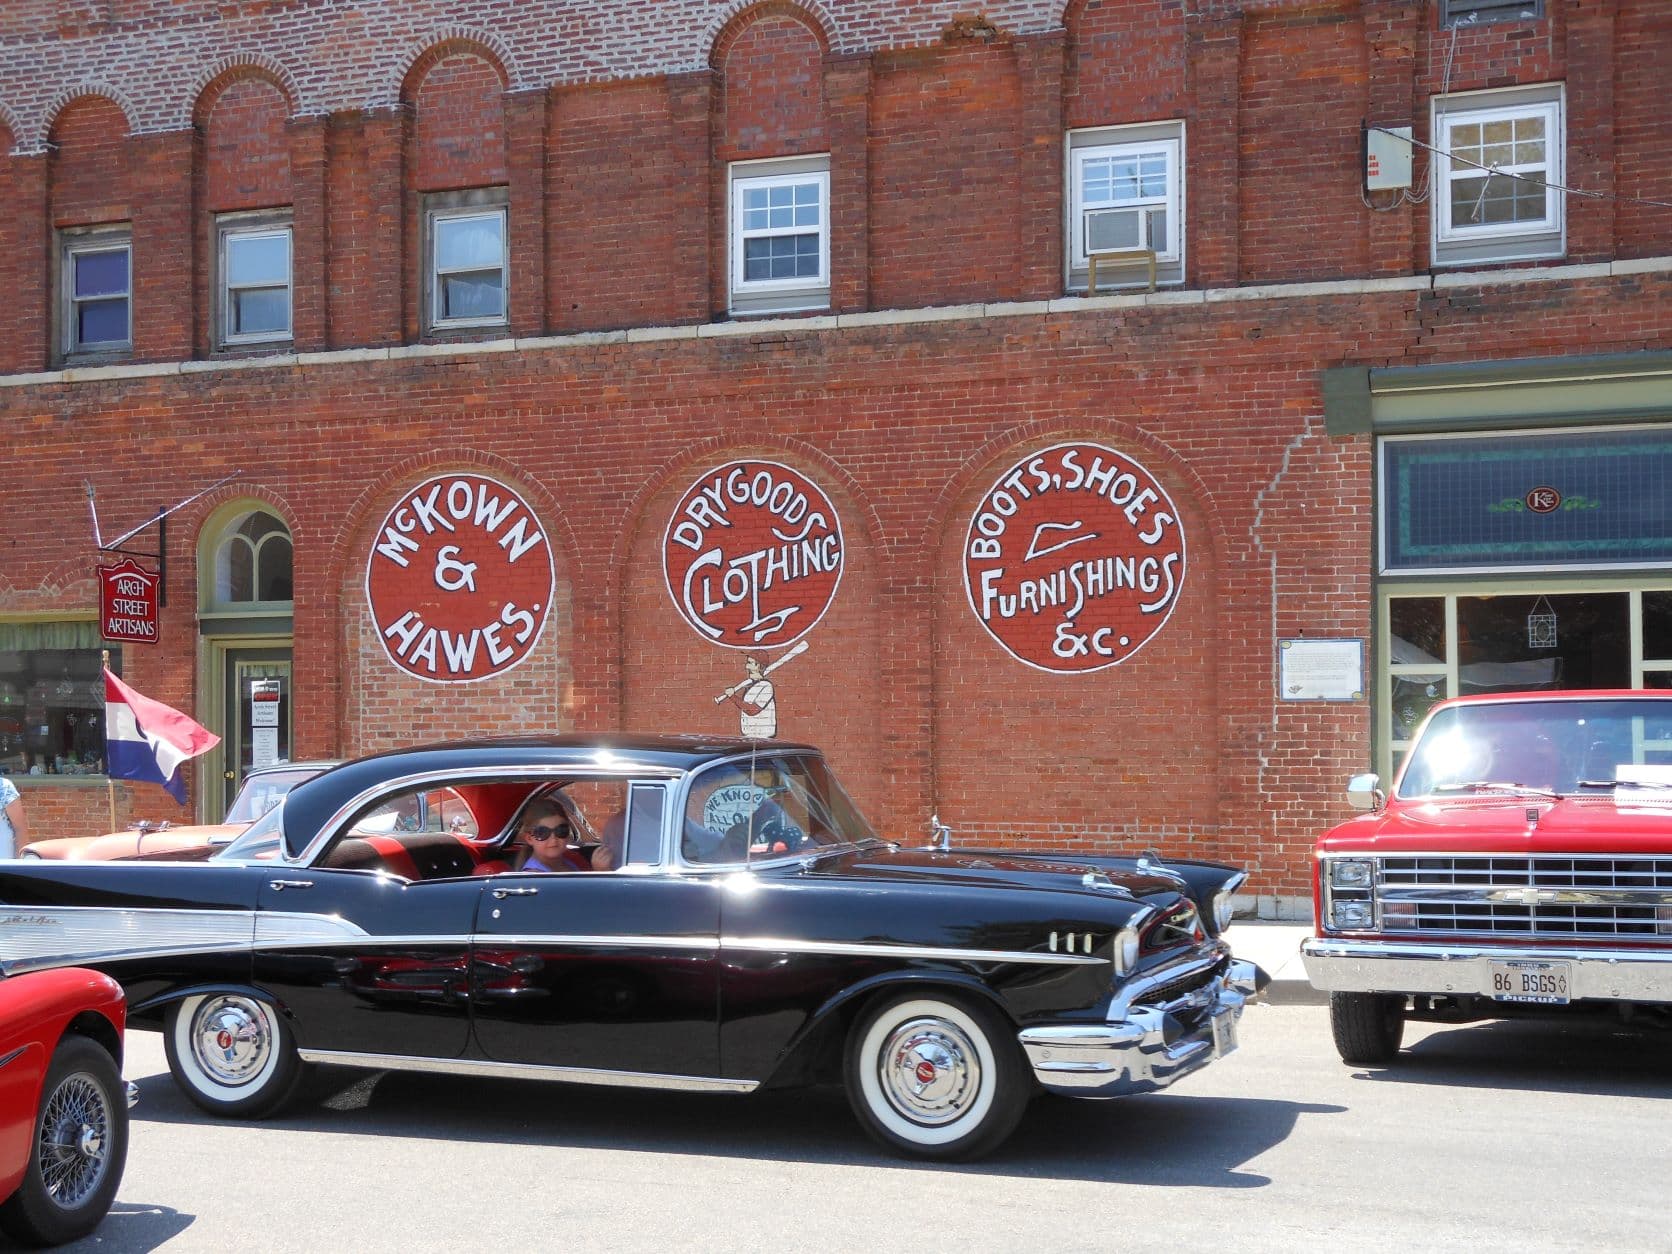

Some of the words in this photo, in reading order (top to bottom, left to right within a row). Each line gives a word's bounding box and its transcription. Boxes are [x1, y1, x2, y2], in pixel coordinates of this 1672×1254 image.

[672, 477, 731, 551] DRY
[726, 467, 829, 542] GOODS
[971, 458, 1061, 559] BOOTS,
[1061, 450, 1174, 545] SHOES
[434, 545, 478, 593] &
[117, 579, 145, 597] ARCH
[683, 534, 840, 642] CLOTHING
[112, 598, 150, 617] STREET
[108, 617, 155, 636] ARTISANS
[1494, 973, 1512, 991] 86
[1502, 994, 1558, 1003] PICKUP
